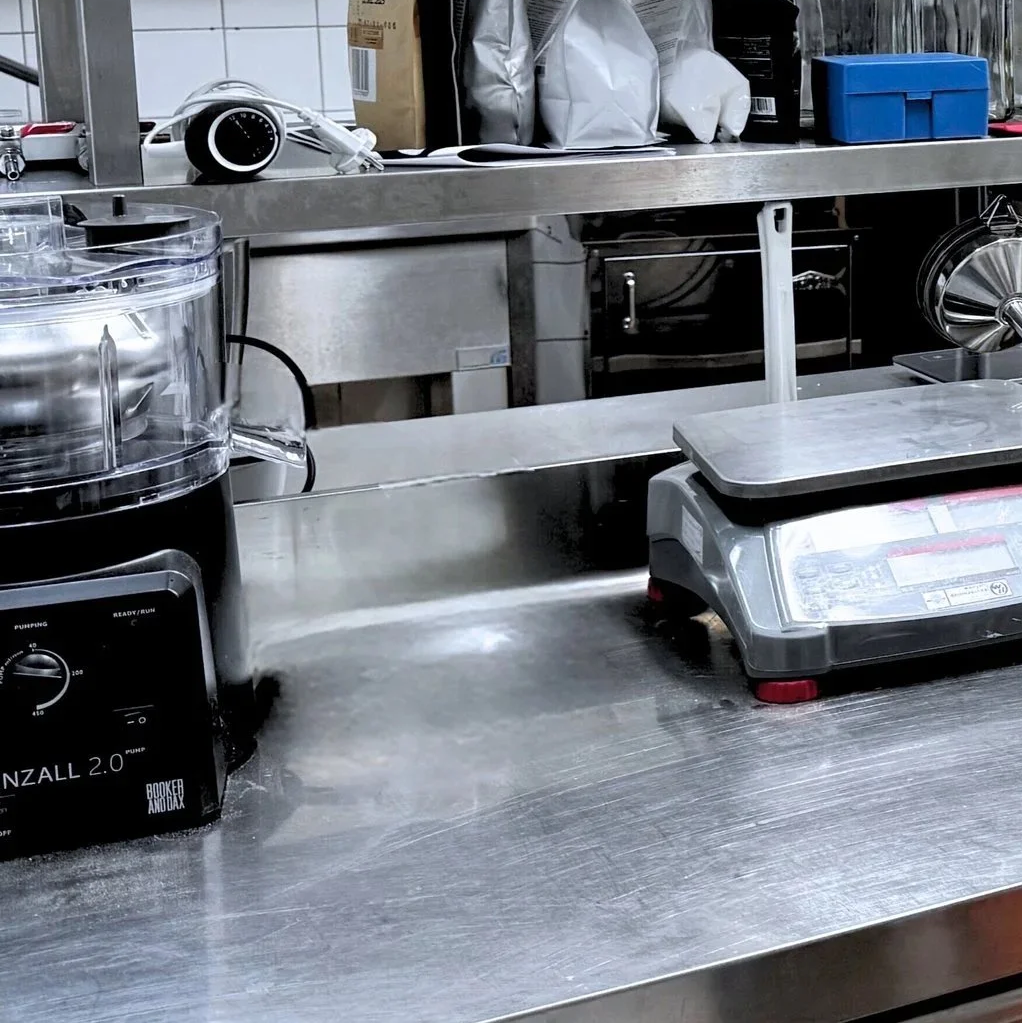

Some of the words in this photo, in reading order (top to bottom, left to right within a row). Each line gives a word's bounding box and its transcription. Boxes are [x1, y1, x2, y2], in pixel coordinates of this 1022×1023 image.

[113, 607, 156, 618] READY/RUN
[14, 621, 48, 630] PUMPING
[71, 669, 84, 677] 100
[2, 762, 81, 790] NZALL
[88, 753, 124, 776] 2.0
[125, 746, 146, 755] PUMP
[146, 778, 184, 800] BOOKER
